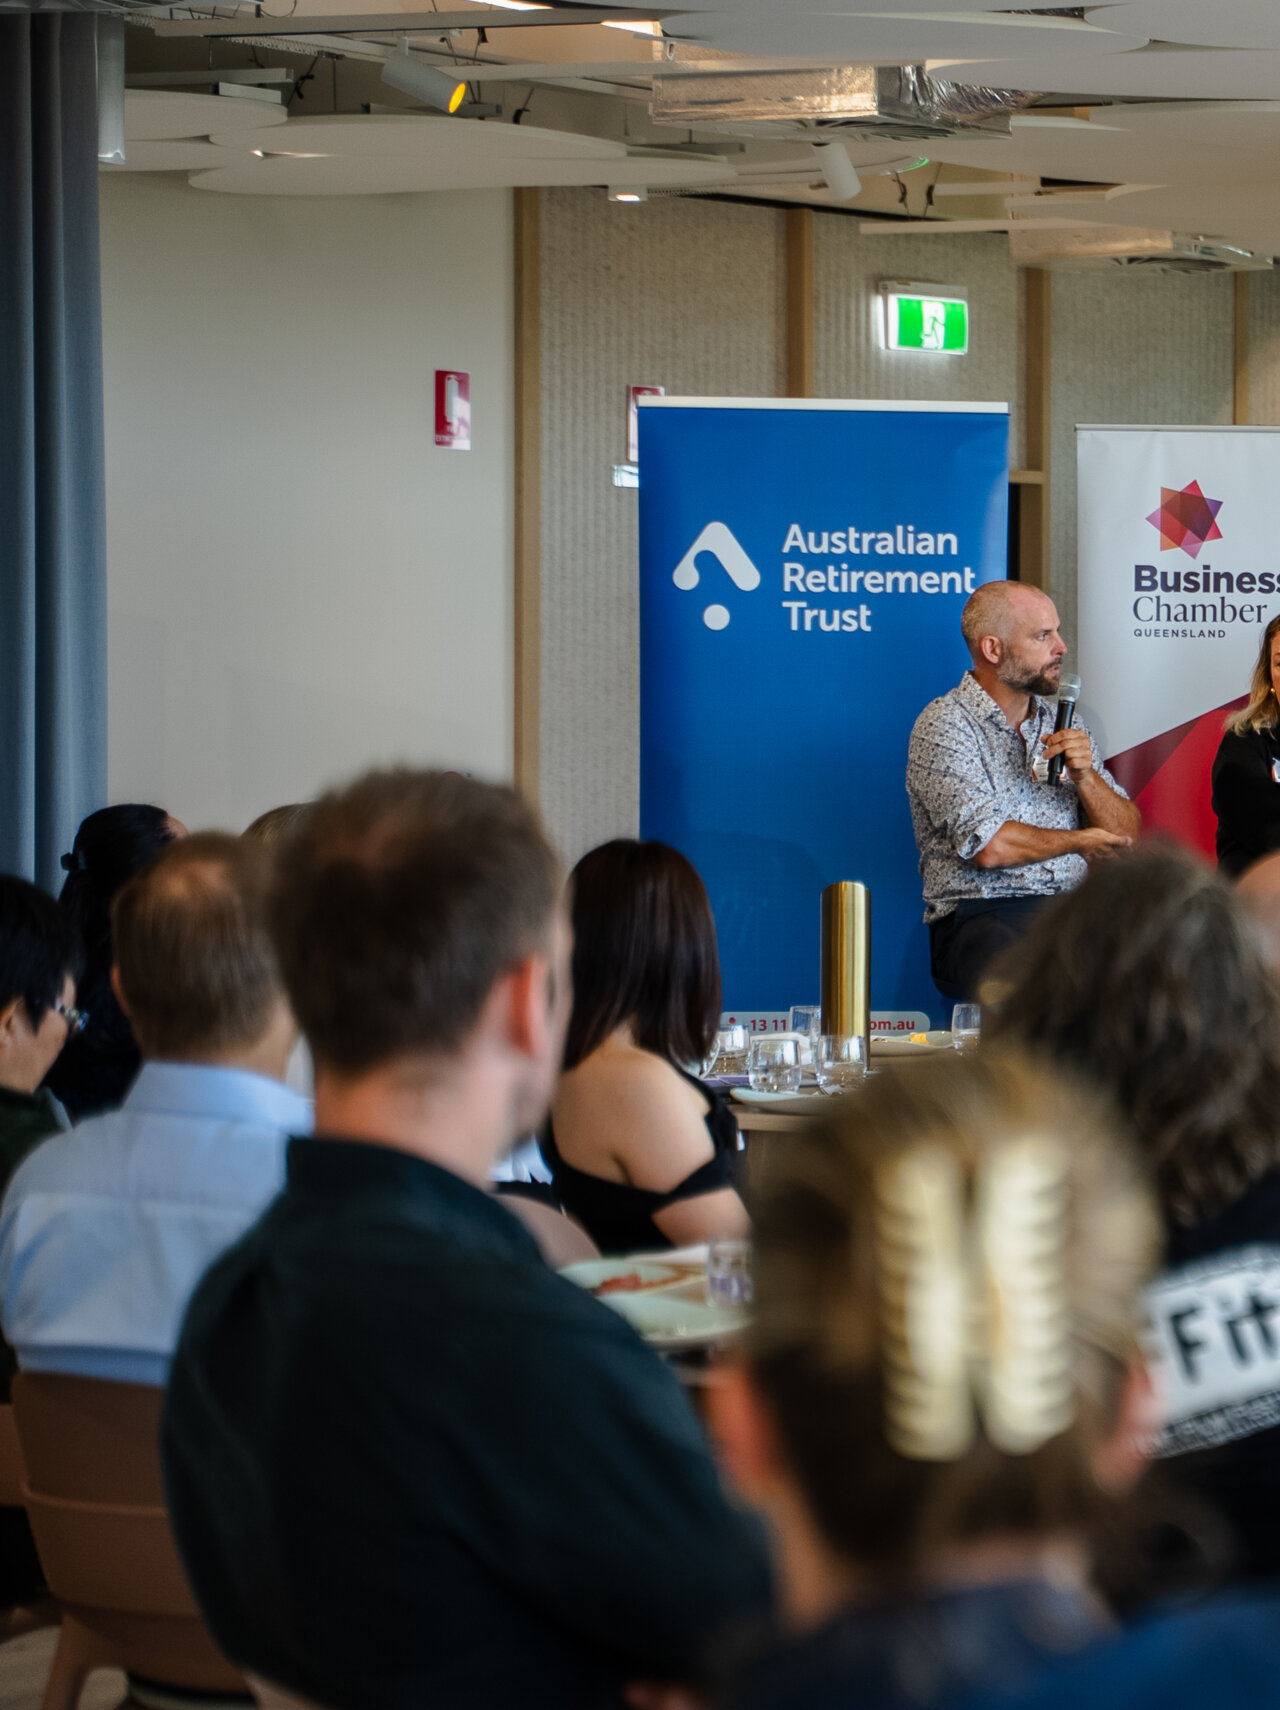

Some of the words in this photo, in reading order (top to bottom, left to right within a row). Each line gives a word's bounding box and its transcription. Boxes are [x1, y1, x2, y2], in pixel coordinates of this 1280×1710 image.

[781, 523, 959, 556] Australian
[782, 561, 977, 595] Retirement
[781, 601, 872, 632] Trust
[1132, 594, 1268, 624] Chamber
[1133, 628, 1227, 639] QUEENSLAND
[750, 1018, 768, 1032] 13
[772, 1018, 787, 1032] 11
